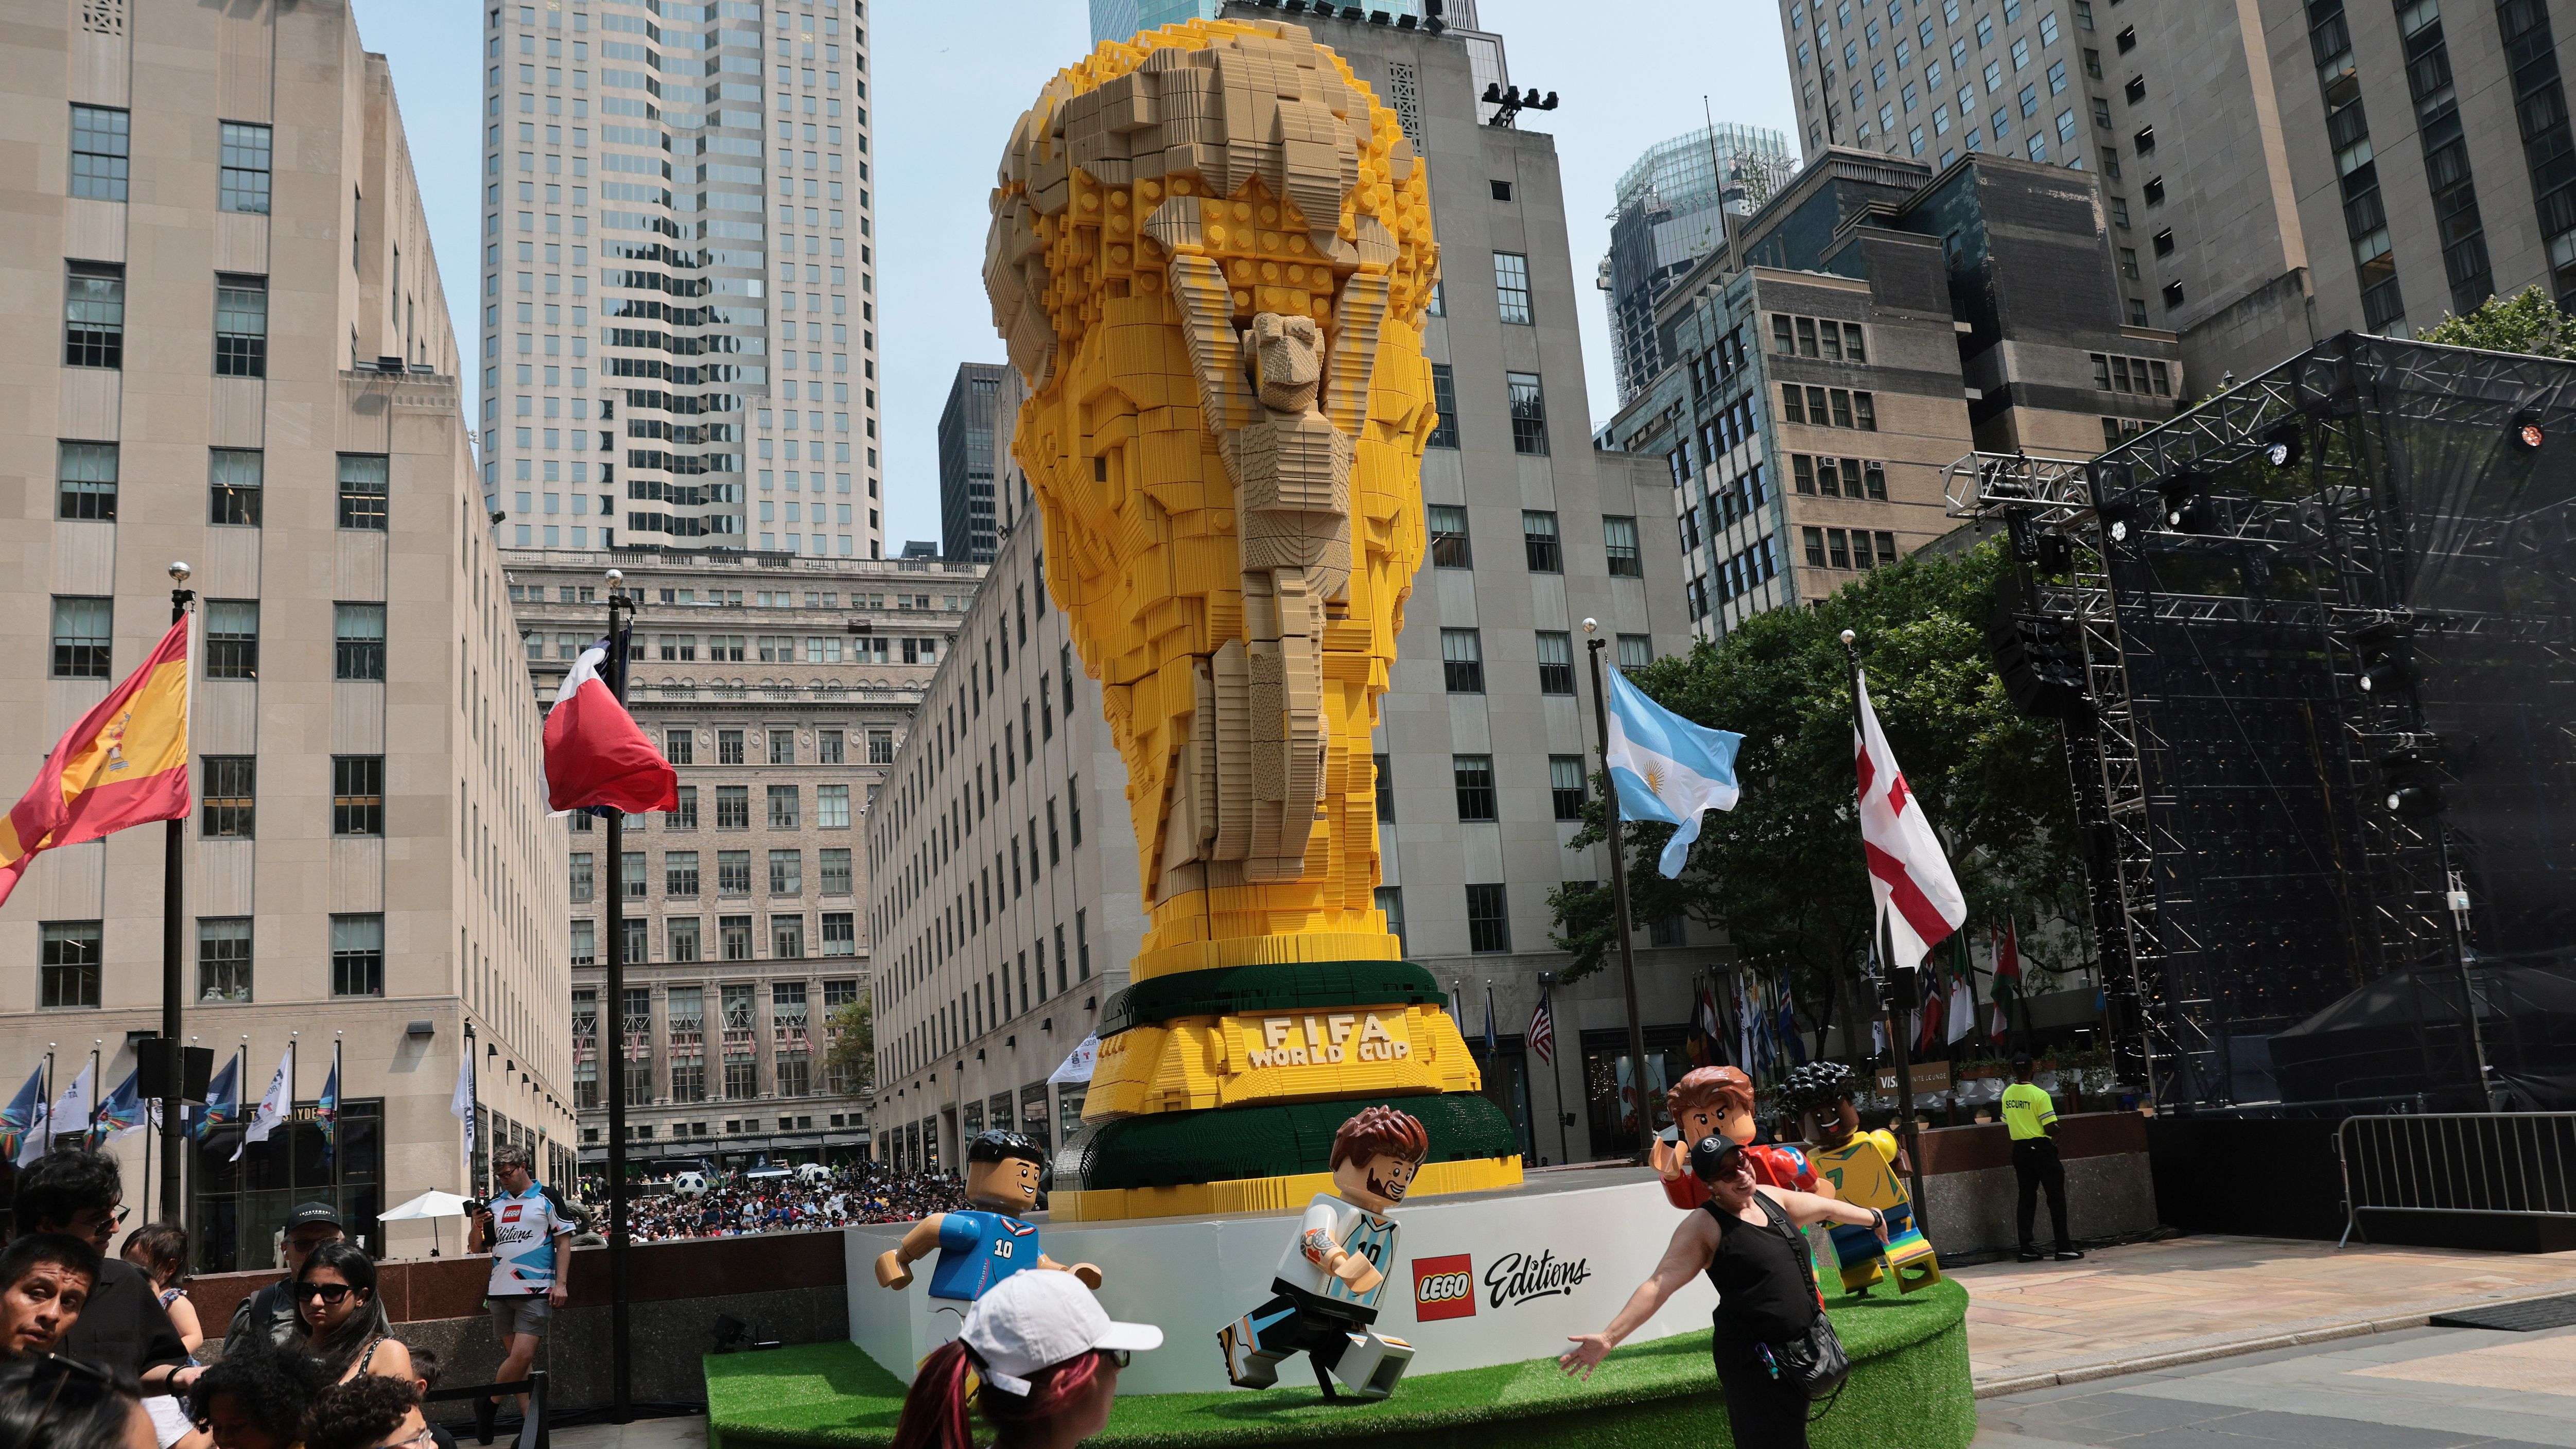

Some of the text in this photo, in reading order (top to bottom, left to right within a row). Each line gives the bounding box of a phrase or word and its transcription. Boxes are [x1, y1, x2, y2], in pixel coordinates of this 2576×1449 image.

[1263, 1012, 1391, 1048] FIFA
[1249, 1041, 1409, 1069] WORLD CUP
[1879, 1076, 1898, 1089] VIS
[1925, 1073, 1946, 1081] LOUNGE
[2006, 1100, 2031, 1110] SECURITY
[1826, 1167, 1843, 1190] 7
[1900, 1216, 1912, 1233] 7
[994, 1238, 1013, 1259] 10
[1419, 1272, 1470, 1302] LEGO
[1484, 1249, 1591, 1308] Editions
